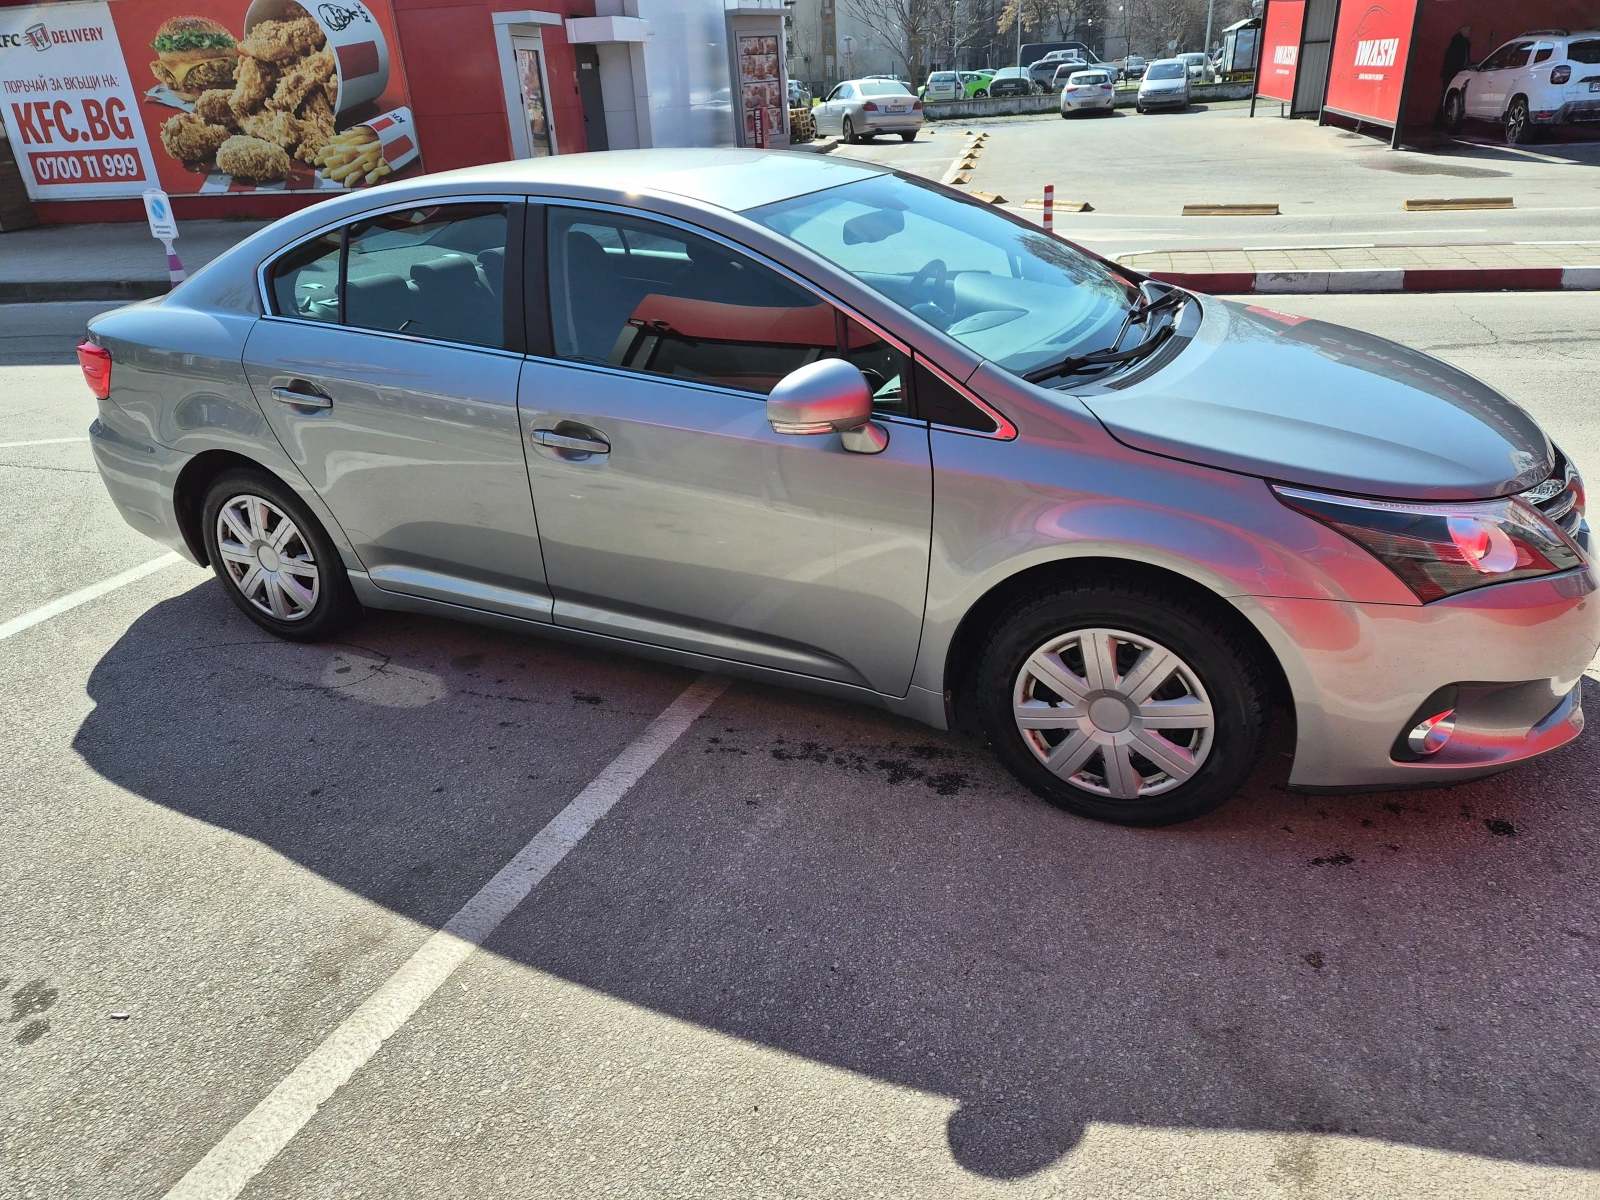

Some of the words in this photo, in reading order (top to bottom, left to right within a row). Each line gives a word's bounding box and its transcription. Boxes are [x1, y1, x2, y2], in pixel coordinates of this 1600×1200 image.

[353, 2, 372, 24] KFC
[51, 27, 104, 44] DELIVERY
[1274, 45, 1298, 66] IWASH
[1354, 37, 1400, 67] IWASH
[4, 74, 48, 94] ПОРЪЧАЙ
[49, 77, 63, 91] ЗА
[63, 75, 101, 91] ВКЪЩИ
[102, 74, 119, 88] НА:
[11, 96, 135, 145] KFC.BG
[389, 112, 406, 124] KFC
[36, 155, 82, 180] 0700
[83, 154, 101, 178] 11
[102, 153, 138, 177] 999
